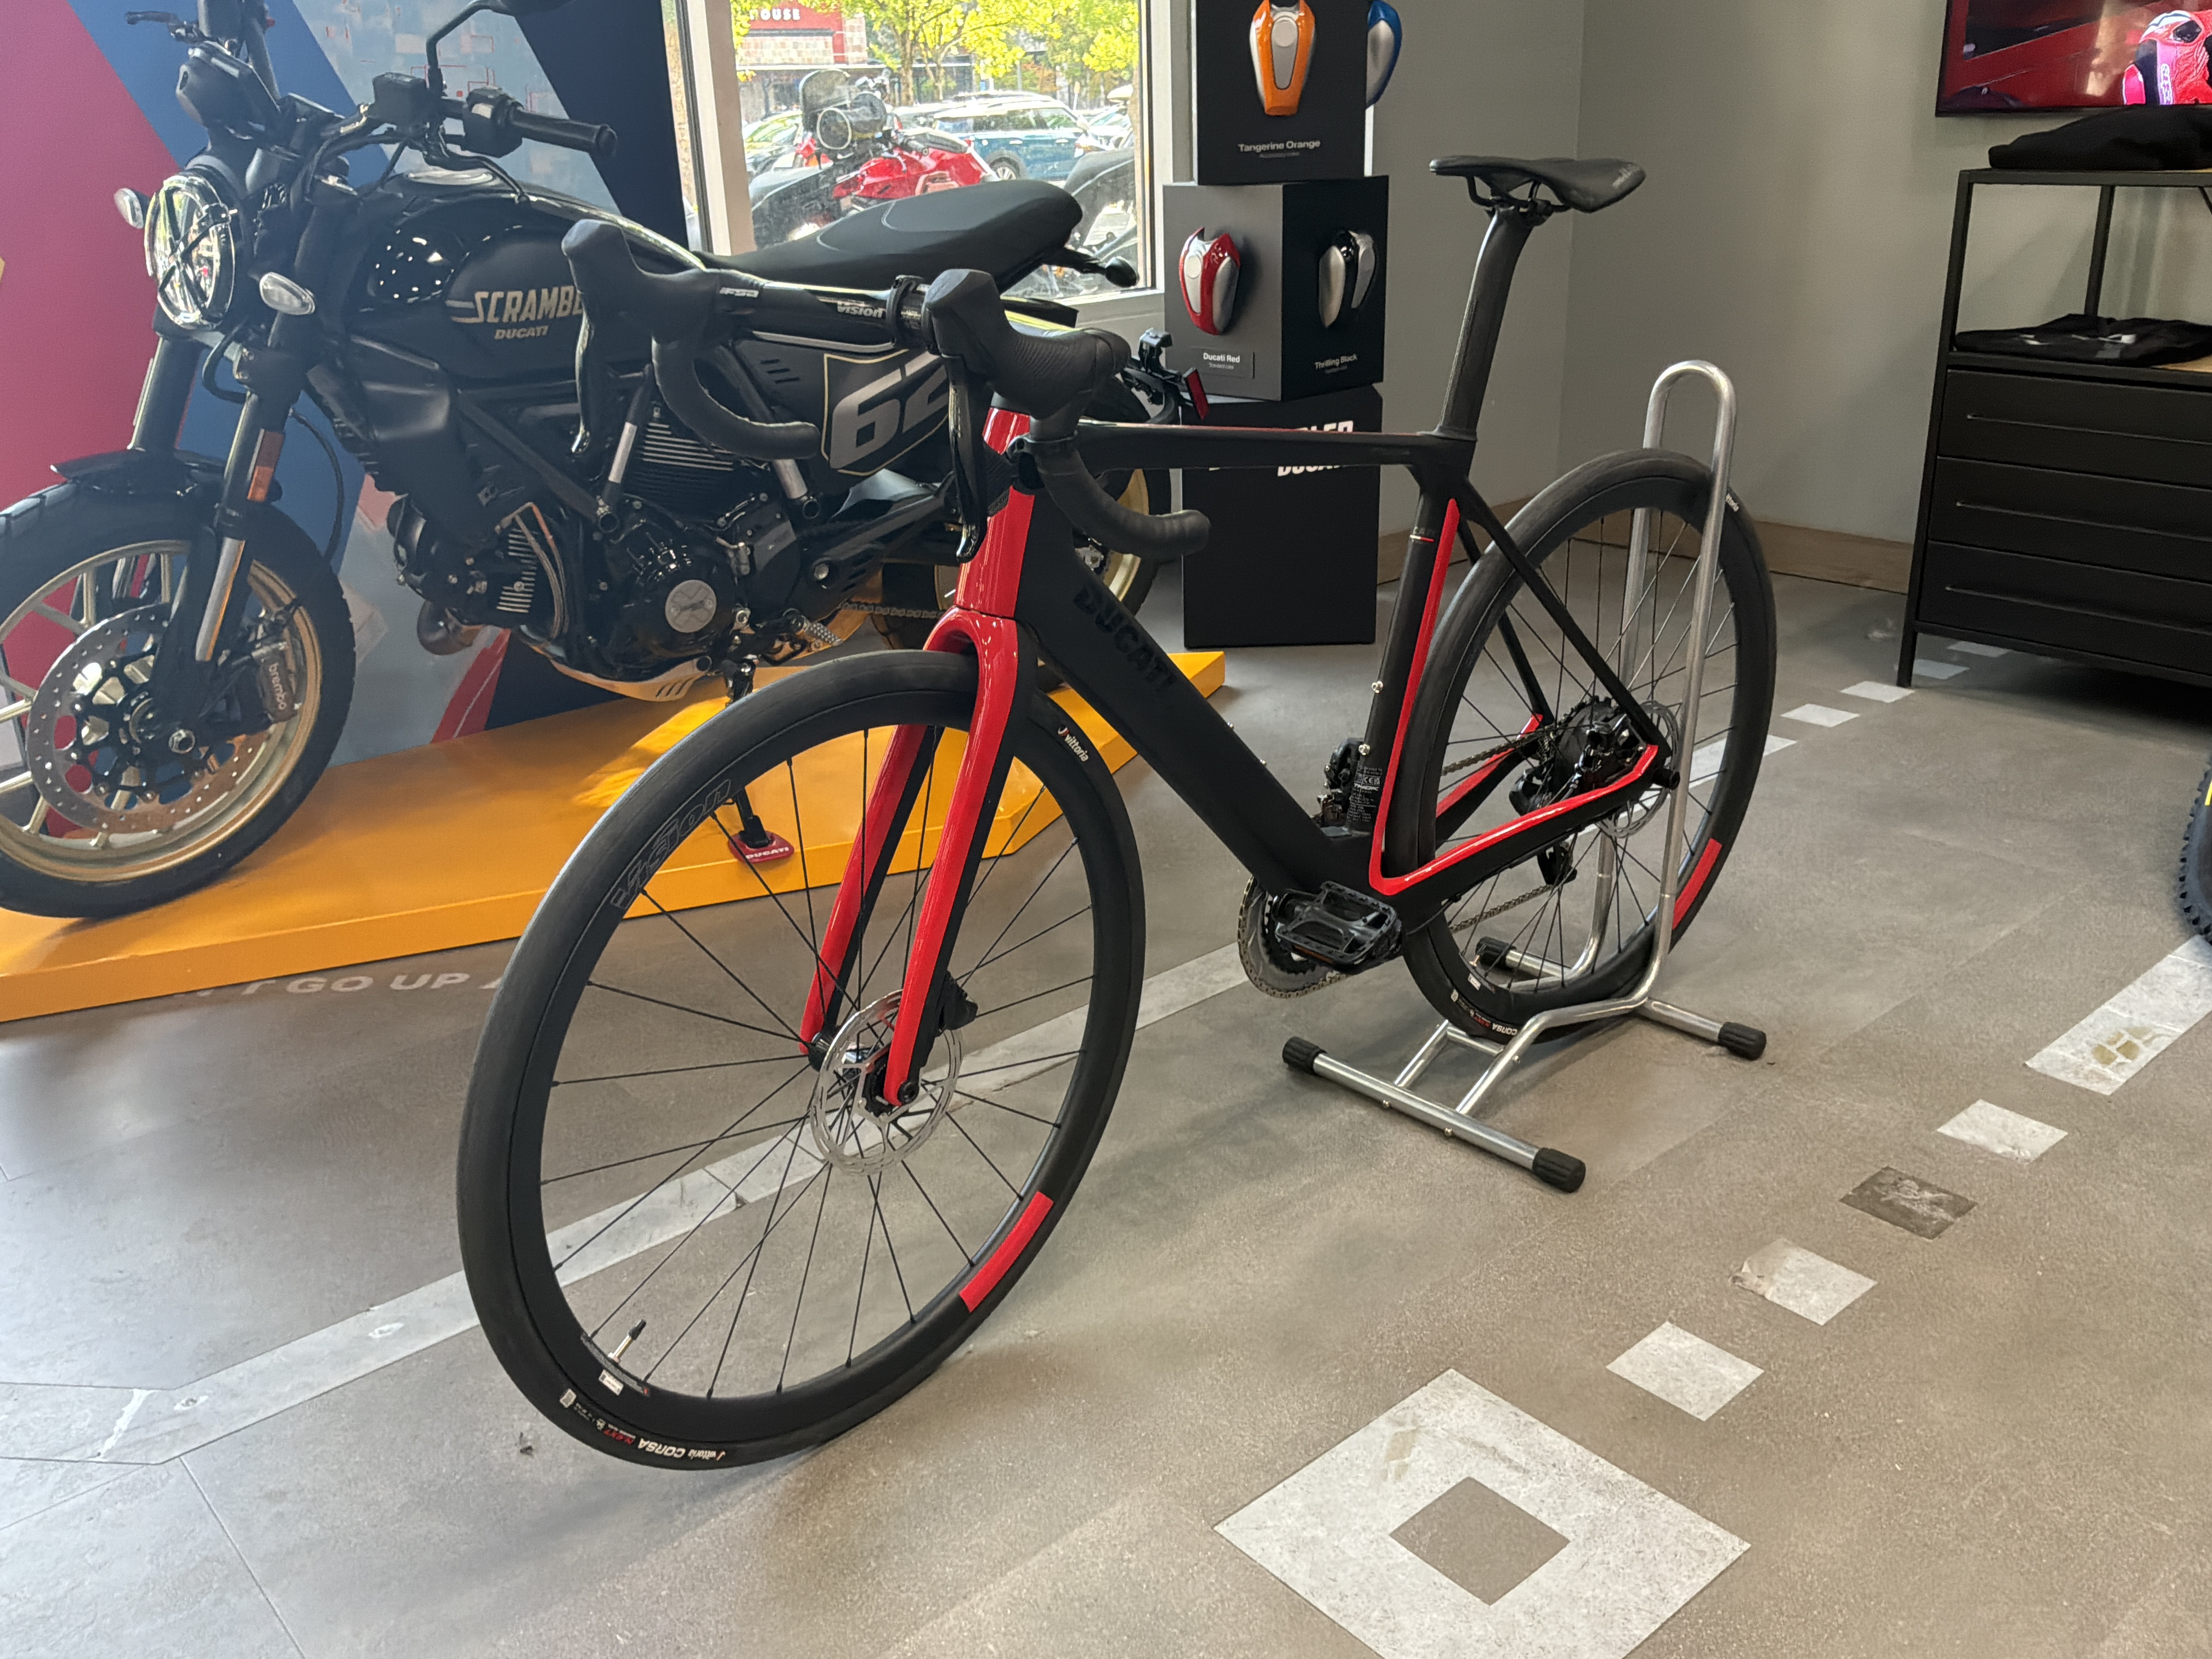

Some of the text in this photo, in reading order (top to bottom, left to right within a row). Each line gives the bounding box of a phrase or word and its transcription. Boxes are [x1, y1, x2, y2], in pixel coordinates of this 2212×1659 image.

[1238, 140, 1321, 153] Tangerine Orange
[450, 285, 584, 324] SCRAMBL
[494, 325, 549, 340] DUCATI
[1203, 352, 1240, 363] Ducati Red
[1073, 584, 1177, 693] DUCATI
[269, 662, 287, 710] brembo
[1064, 733, 1089, 762] vittoria
[746, 847, 789, 859] DUCATI
[286, 976, 374, 994] GO
[389, 972, 471, 991] UP
[1492, 1022, 1518, 1036] CORSA
[637, 1437, 716, 1460] vittoria CORSA
